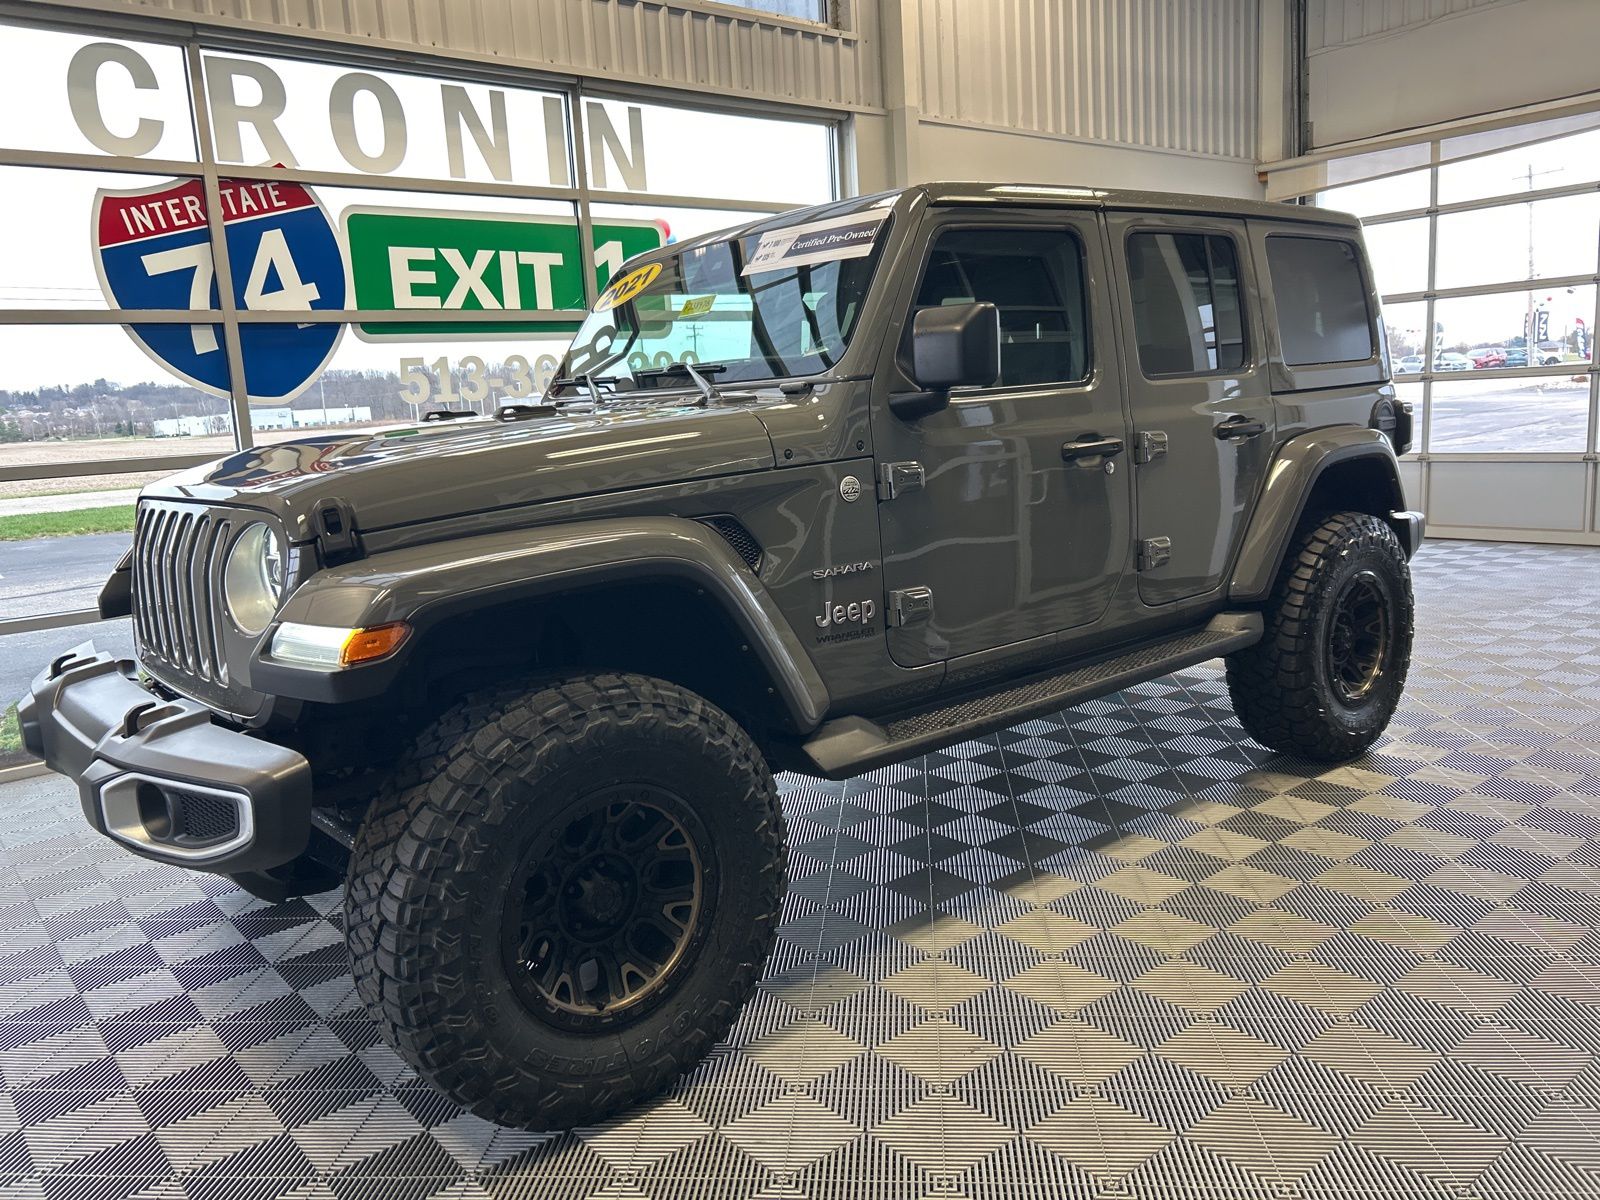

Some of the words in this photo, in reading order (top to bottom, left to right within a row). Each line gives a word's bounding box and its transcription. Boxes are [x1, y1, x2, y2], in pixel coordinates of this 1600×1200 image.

[67, 42, 647, 191] CRONIN
[120, 182, 288, 236] INTERTATE
[792, 239, 826, 250] Certified
[826, 228, 877, 243] Pre-Owned
[141, 228, 321, 355] 74
[388, 246, 563, 310] EXIT
[601, 269, 653, 306] 2021
[813, 561, 873, 579] SAHARA
[815, 599, 875, 627] Jeep
[816, 626, 876, 644] WRANGLER
